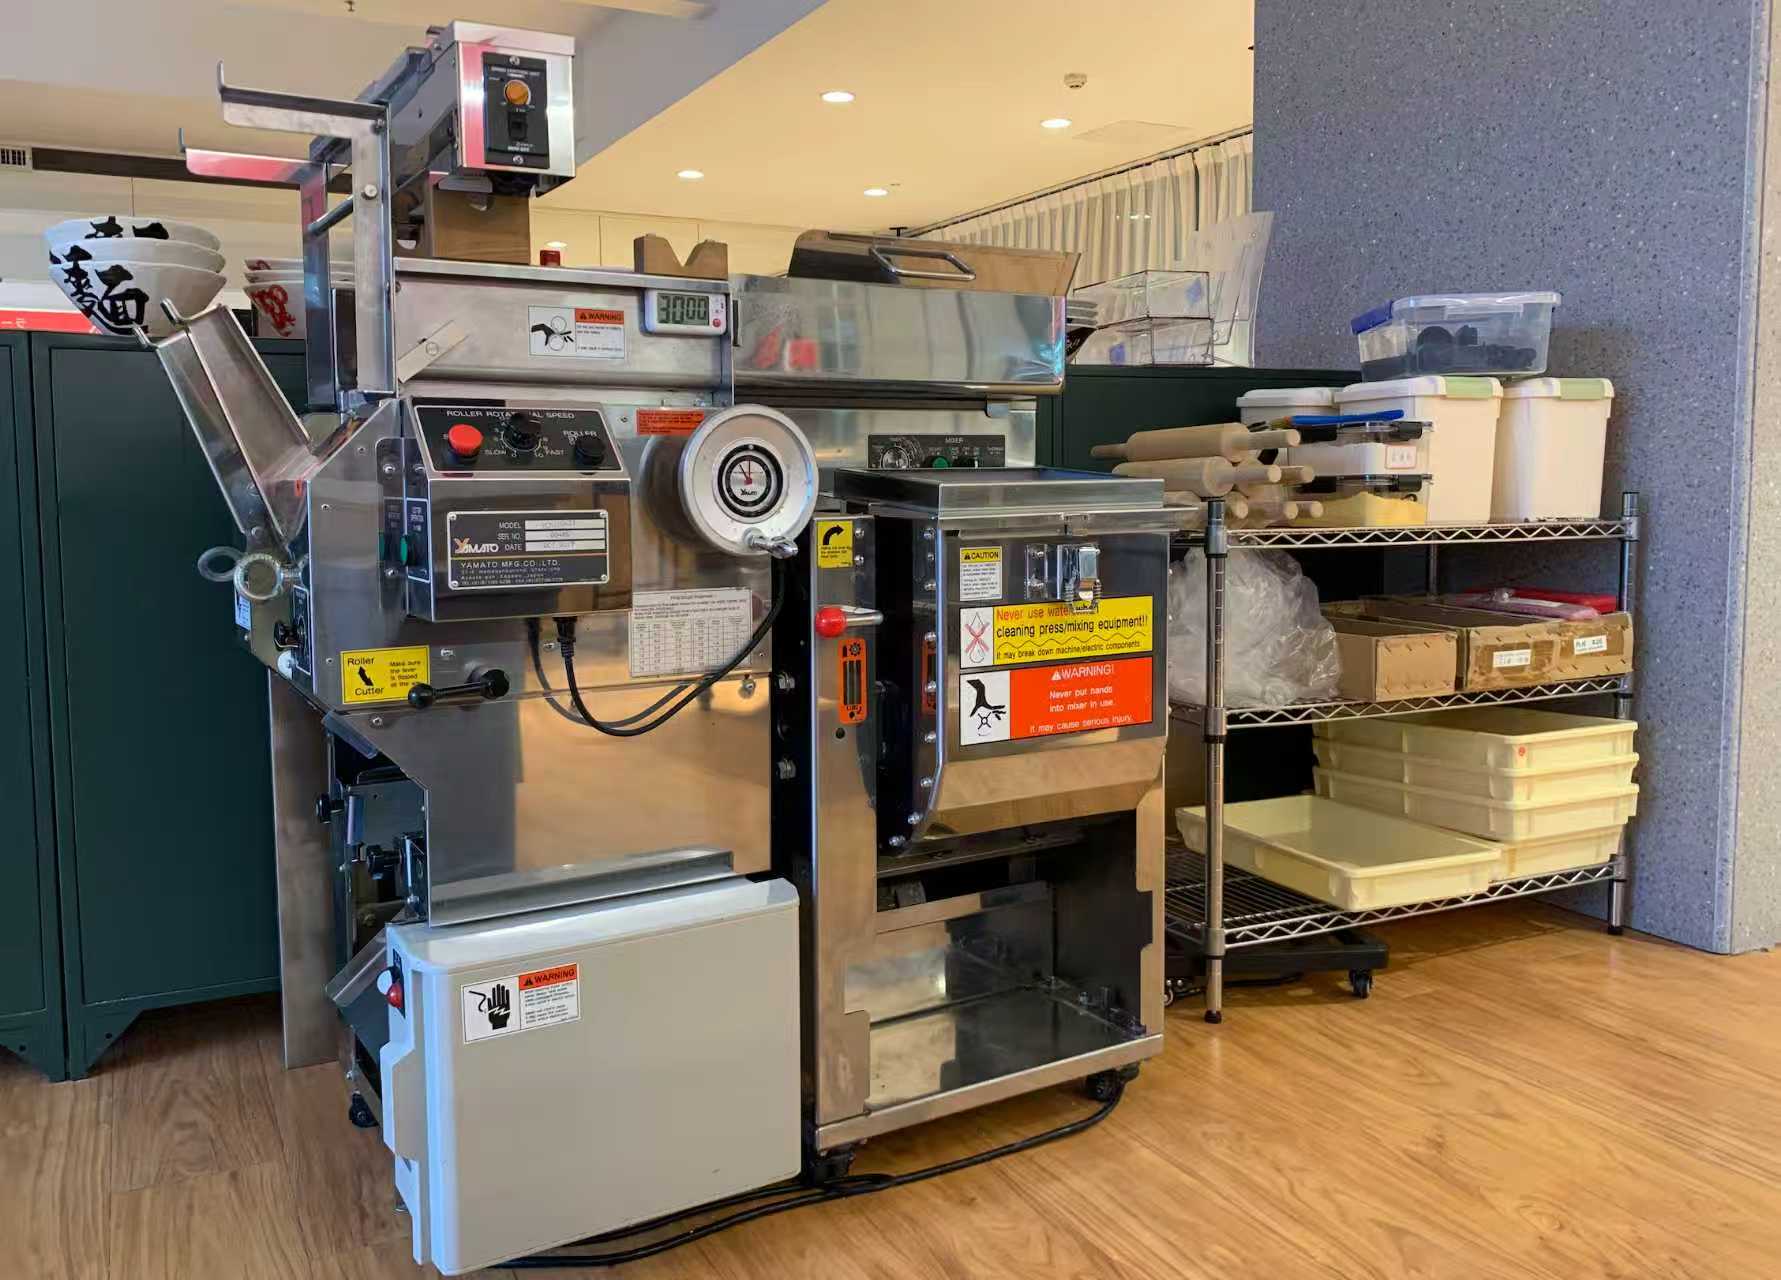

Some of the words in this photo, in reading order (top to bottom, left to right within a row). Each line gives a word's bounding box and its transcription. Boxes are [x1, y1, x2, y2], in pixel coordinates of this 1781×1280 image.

[589, 312, 623, 321] WARNING
[499, 521, 521, 529] MODEL
[454, 537, 499, 553] YAMATO
[504, 543, 522, 551] DATE
[971, 551, 999, 559] CAUTION
[997, 608, 1024, 621] Never
[1028, 608, 1044, 618] use
[997, 624, 1035, 637] cleaning
[1040, 619, 1094, 635] press/mixing
[1098, 614, 1149, 631] equipment!!
[1004, 650, 1016, 660] may
[1018, 648, 1035, 658] break
[1038, 646, 1054, 656] down
[347, 657, 375, 667] Roller
[1061, 663, 1115, 679] WARNING!
[355, 687, 385, 697] Cutter
[1049, 690, 1073, 699] Never
[1091, 686, 1113, 695] hands
[1068, 701, 1087, 711] mixer
[1090, 700, 1097, 709] in
[1038, 723, 1054, 734] may
[1057, 720, 1080, 730] cause
[1083, 717, 1110, 728] serious
[535, 968, 575, 983] WARNING
